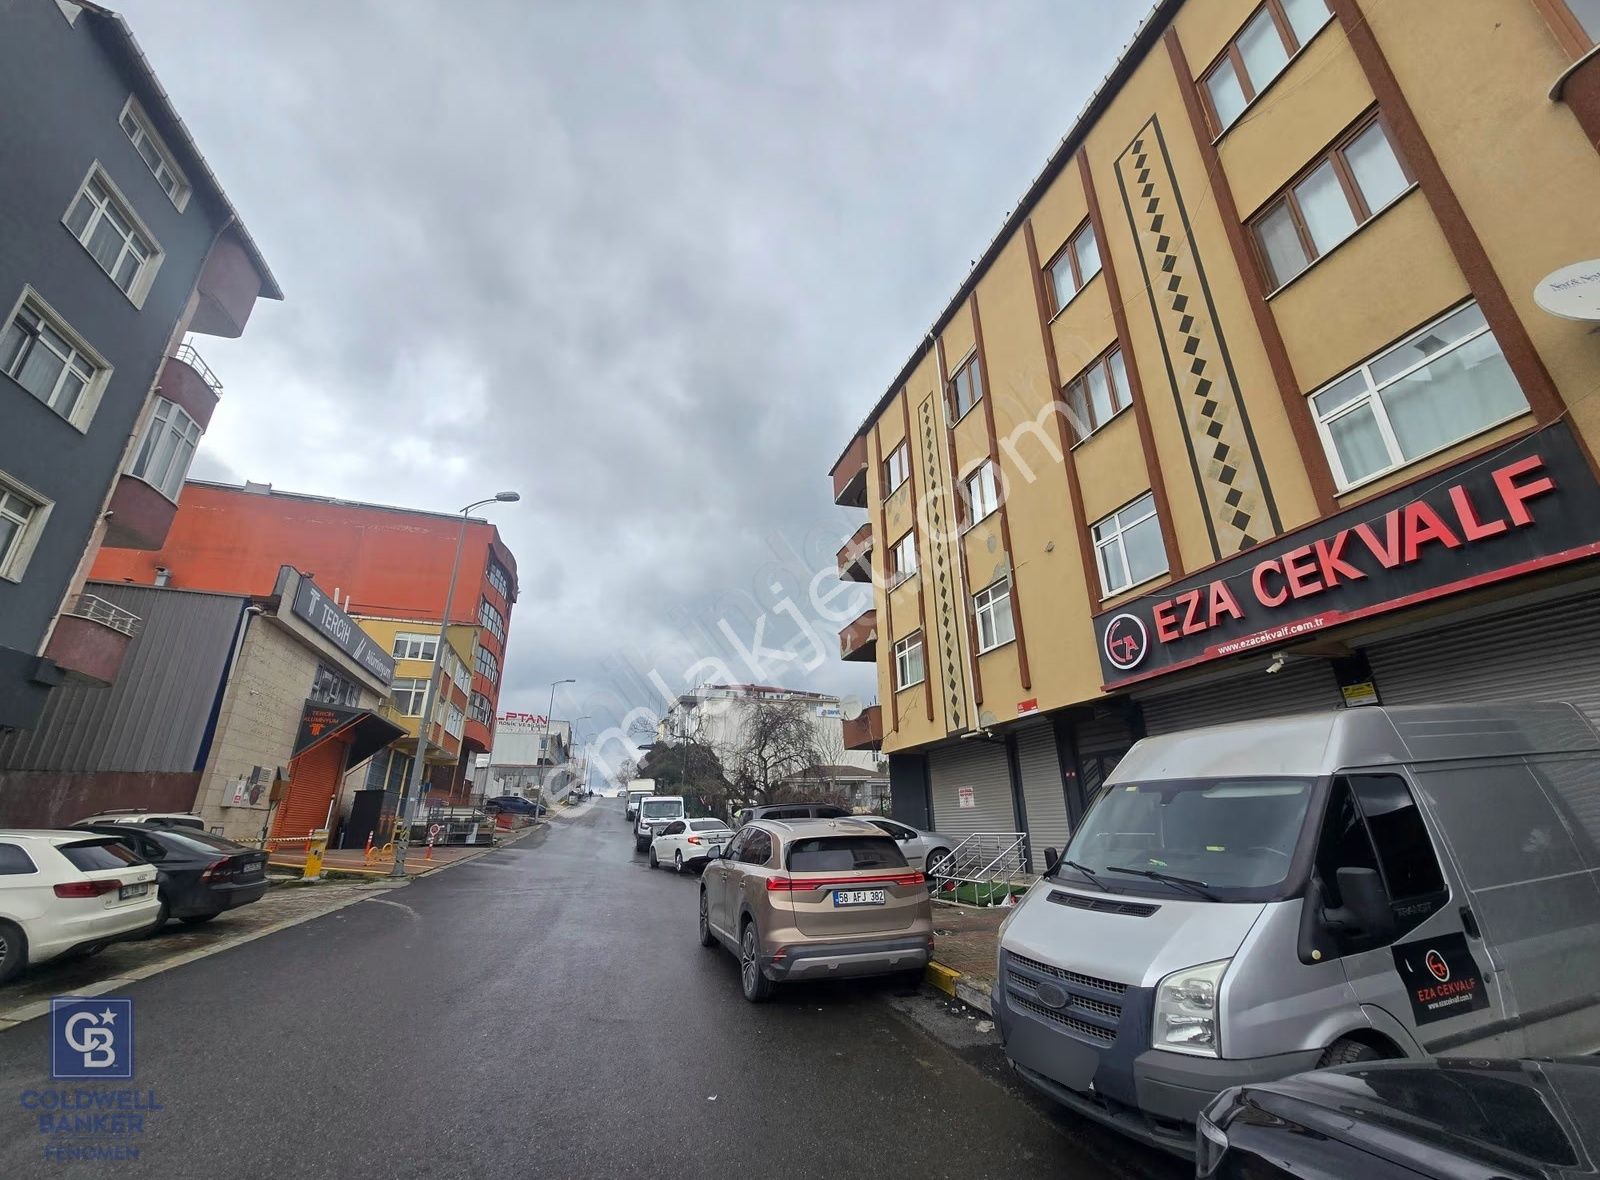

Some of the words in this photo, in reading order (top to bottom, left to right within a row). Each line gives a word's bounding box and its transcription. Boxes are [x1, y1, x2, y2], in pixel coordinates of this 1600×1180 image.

[1152, 580, 1246, 643] EZA
[1252, 454, 1556, 607] CEKVALF
[1218, 617, 1324, 654] www.ezacekvalf.com.tr
[839, 892, 849, 903] 58
[853, 891, 867, 902] AFJ
[870, 890, 884, 901] 382
[1418, 988, 1437, 1001] EZA
[1437, 978, 1475, 996] CEKVALF
